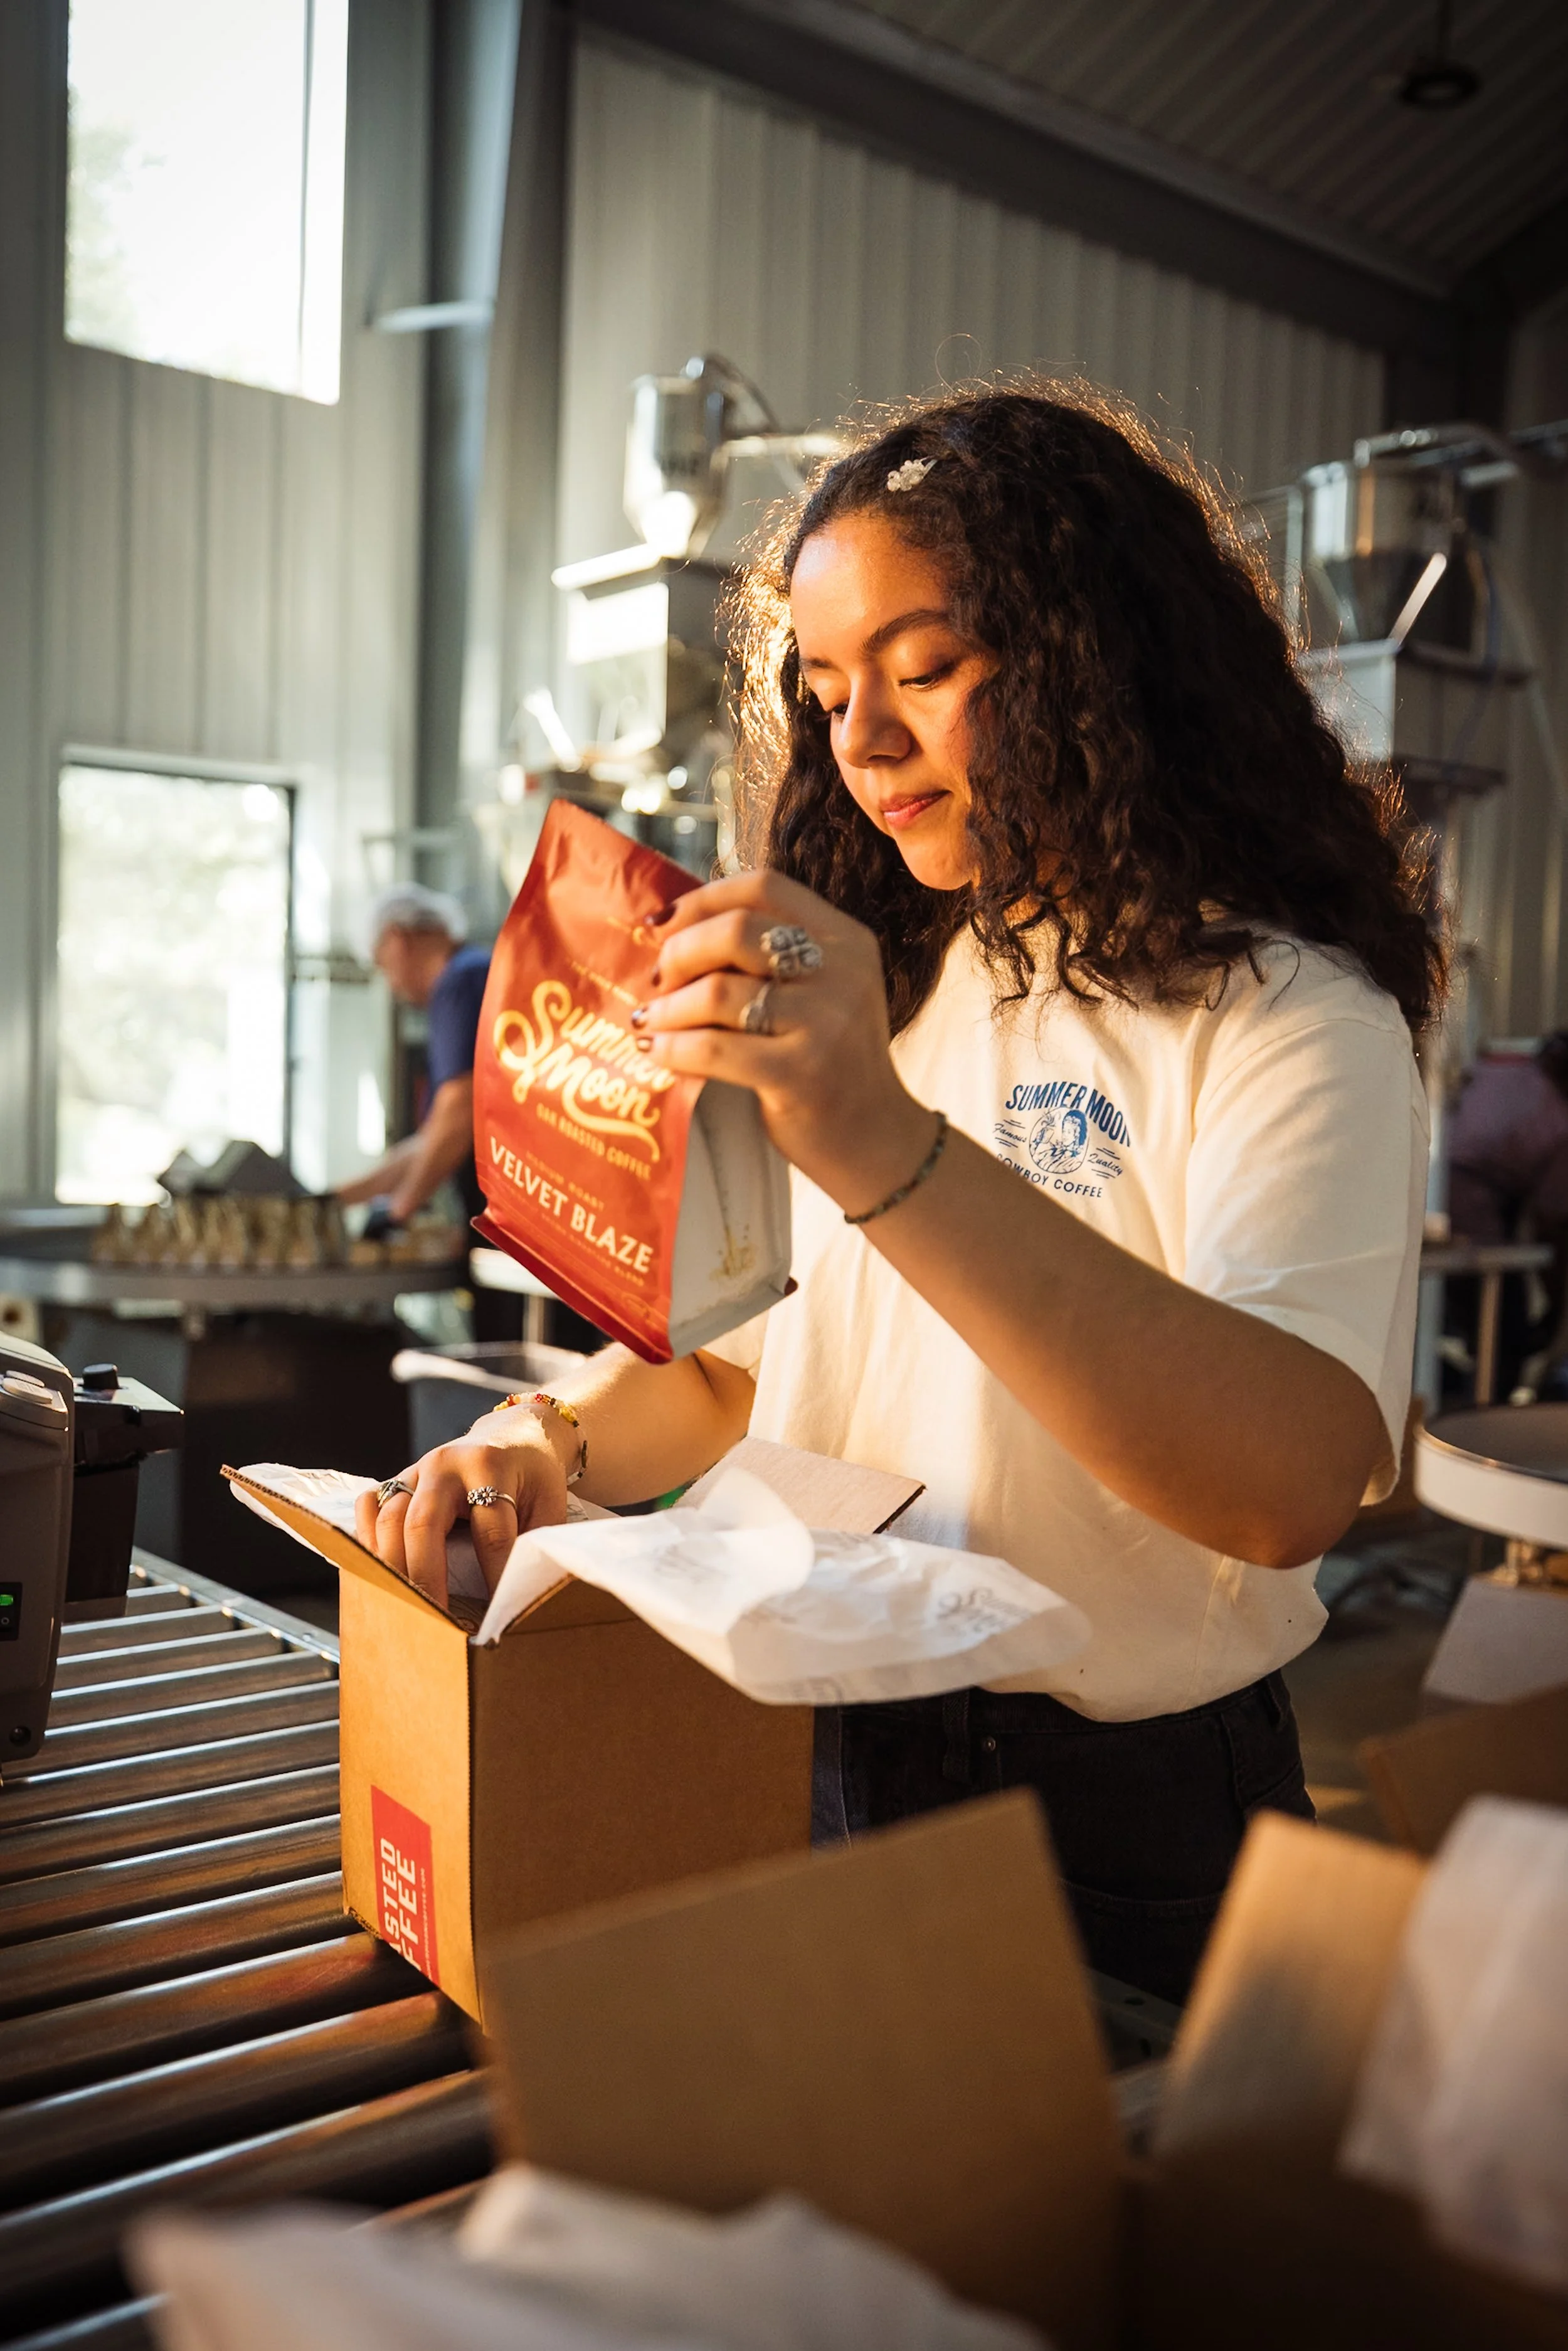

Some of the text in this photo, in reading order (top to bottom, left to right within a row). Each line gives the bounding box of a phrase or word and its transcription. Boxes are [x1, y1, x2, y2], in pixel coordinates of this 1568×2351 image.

[536, 1043, 660, 1162] Moon
[1005, 1081, 1088, 1111] SUMMER
[992, 1122, 1027, 1143] Famous
[1088, 1153, 1123, 1176] Quality
[1054, 1179, 1103, 1198] COFFEE
[489, 1135, 569, 1218] VELVET
[569, 1202, 654, 1275] BLAZE
